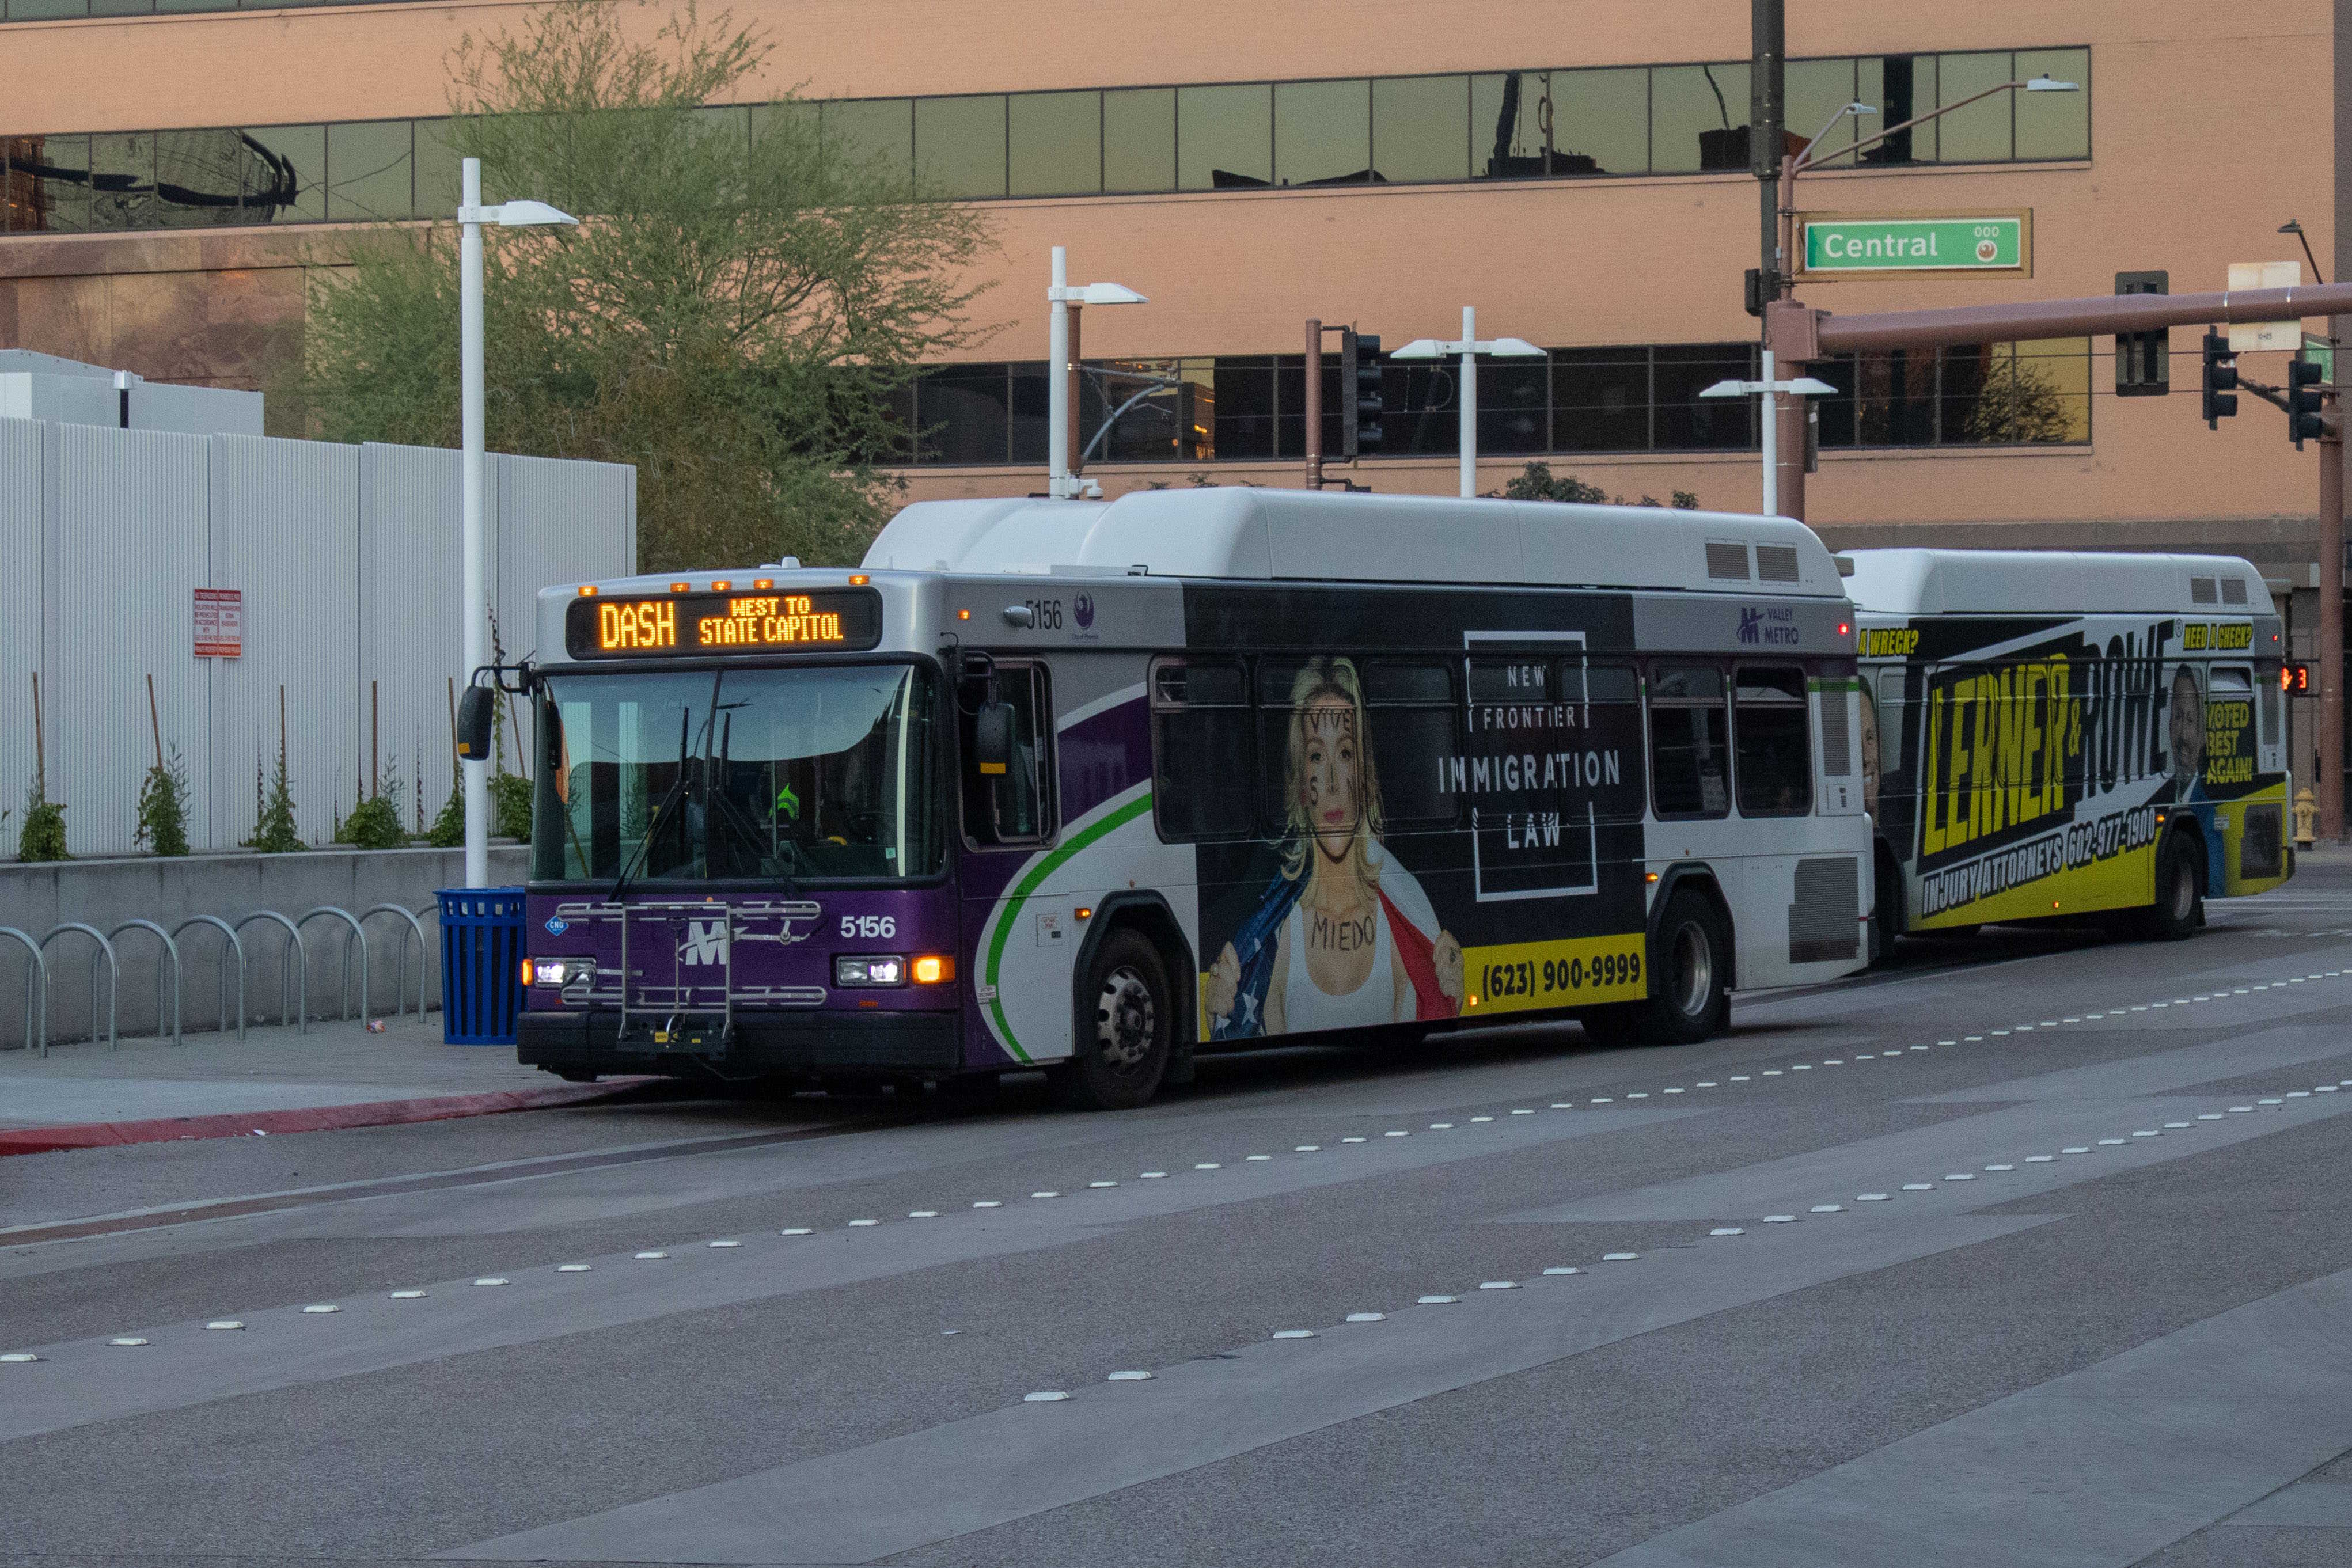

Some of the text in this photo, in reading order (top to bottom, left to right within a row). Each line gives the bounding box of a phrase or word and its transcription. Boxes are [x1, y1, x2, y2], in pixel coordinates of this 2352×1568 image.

[1824, 231, 1938, 258] Central
[730, 596, 812, 617] WEST TO
[1025, 599, 1063, 630] 5156
[1767, 608, 1793, 621] VALLEY
[599, 601, 676, 649] DASH
[699, 613, 844, 644] STATE CAPITOL
[1764, 625, 1799, 644] METRO
[2184, 624, 2252, 650] NEED A CHECK?
[1869, 628, 1919, 655] WRECK?
[1507, 665, 1547, 687] NEW
[2298, 668, 2307, 689] 3
[1483, 706, 1576, 730] FRONTIER
[2207, 702, 2249, 729] VOTED
[1924, 652, 2070, 857] LERNER
[2068, 698, 2081, 757] &
[2206, 730, 2240, 757] BEST
[1439, 749, 1620, 794] IMMIGRATION
[2207, 756, 2253, 784] AGAIN!
[1507, 811, 1560, 849] LAW
[1922, 807, 2156, 914] INJURY ATTORNEYS 602-977-1900
[840, 916, 896, 939] 5156
[1310, 911, 1376, 951] MIEDO
[1482, 952, 1641, 1002] (623) 900-9999
